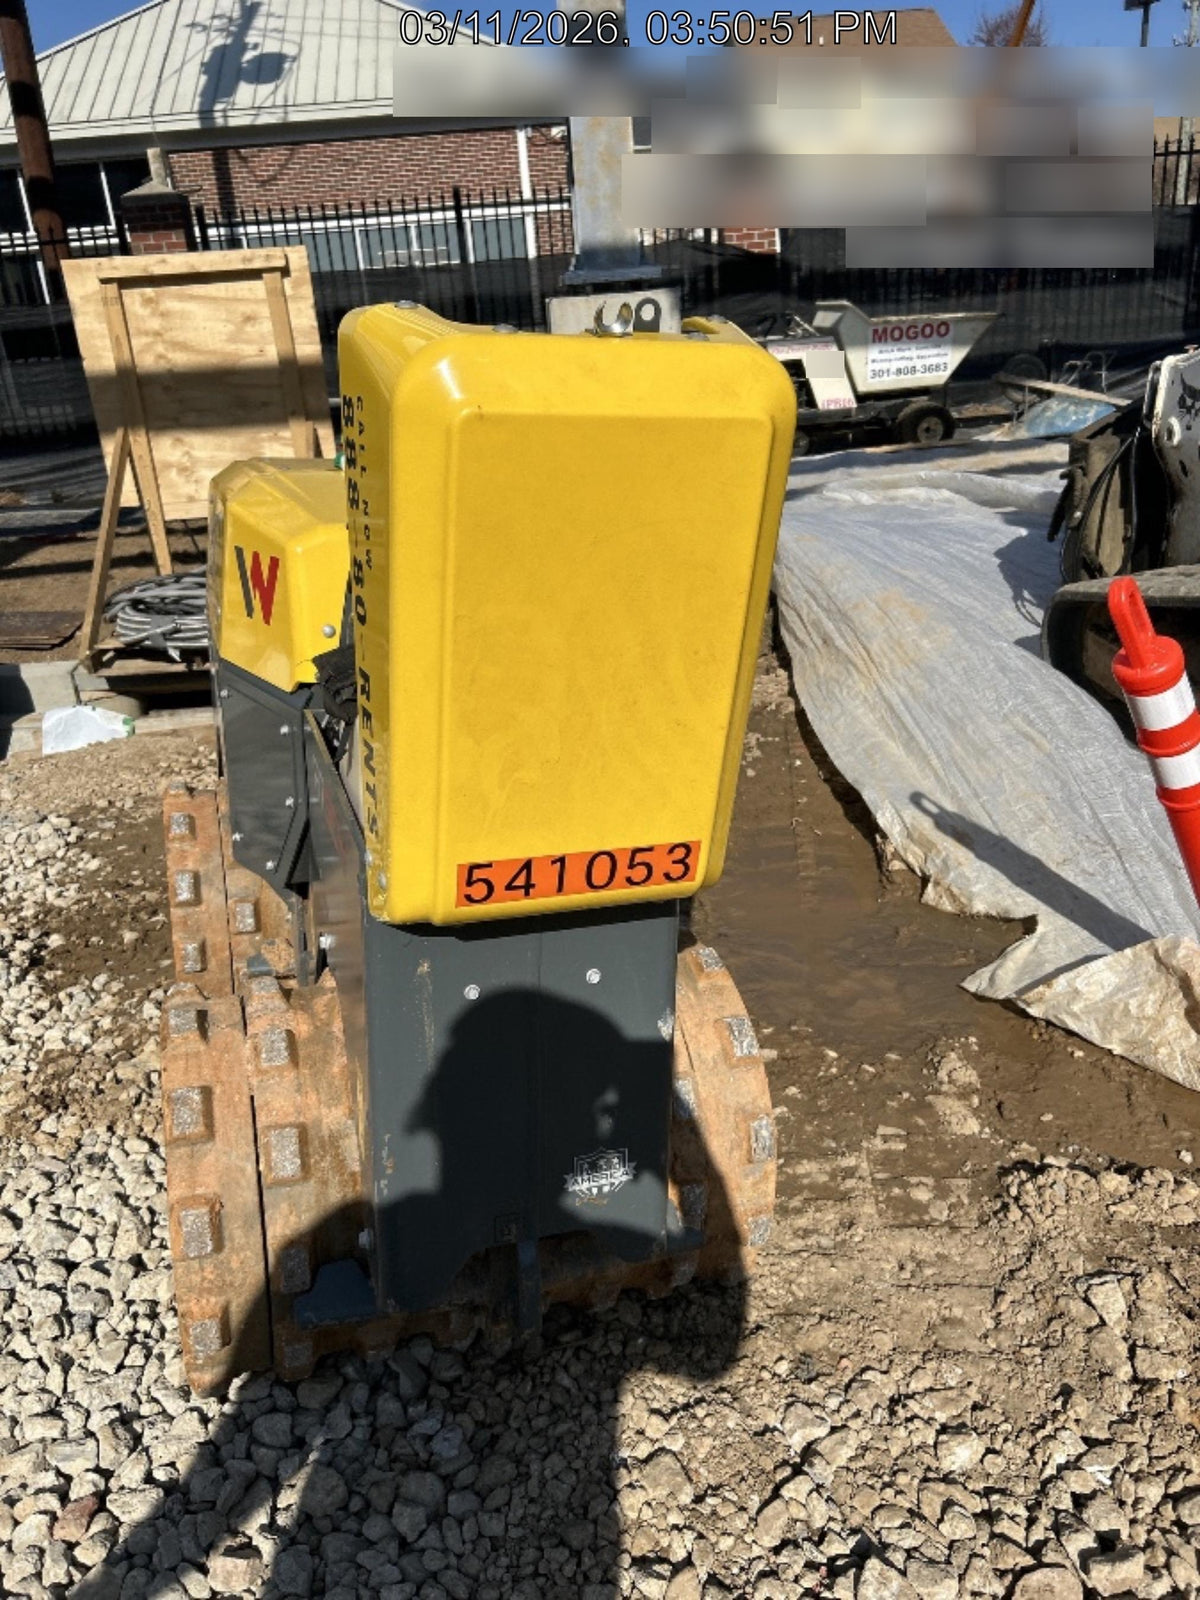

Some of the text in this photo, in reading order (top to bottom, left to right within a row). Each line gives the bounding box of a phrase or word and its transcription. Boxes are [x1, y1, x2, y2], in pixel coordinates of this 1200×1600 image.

[872, 321, 950, 343] MOGOO
[356, 395, 372, 570] CALL NOW
[463, 842, 693, 904] 541053
